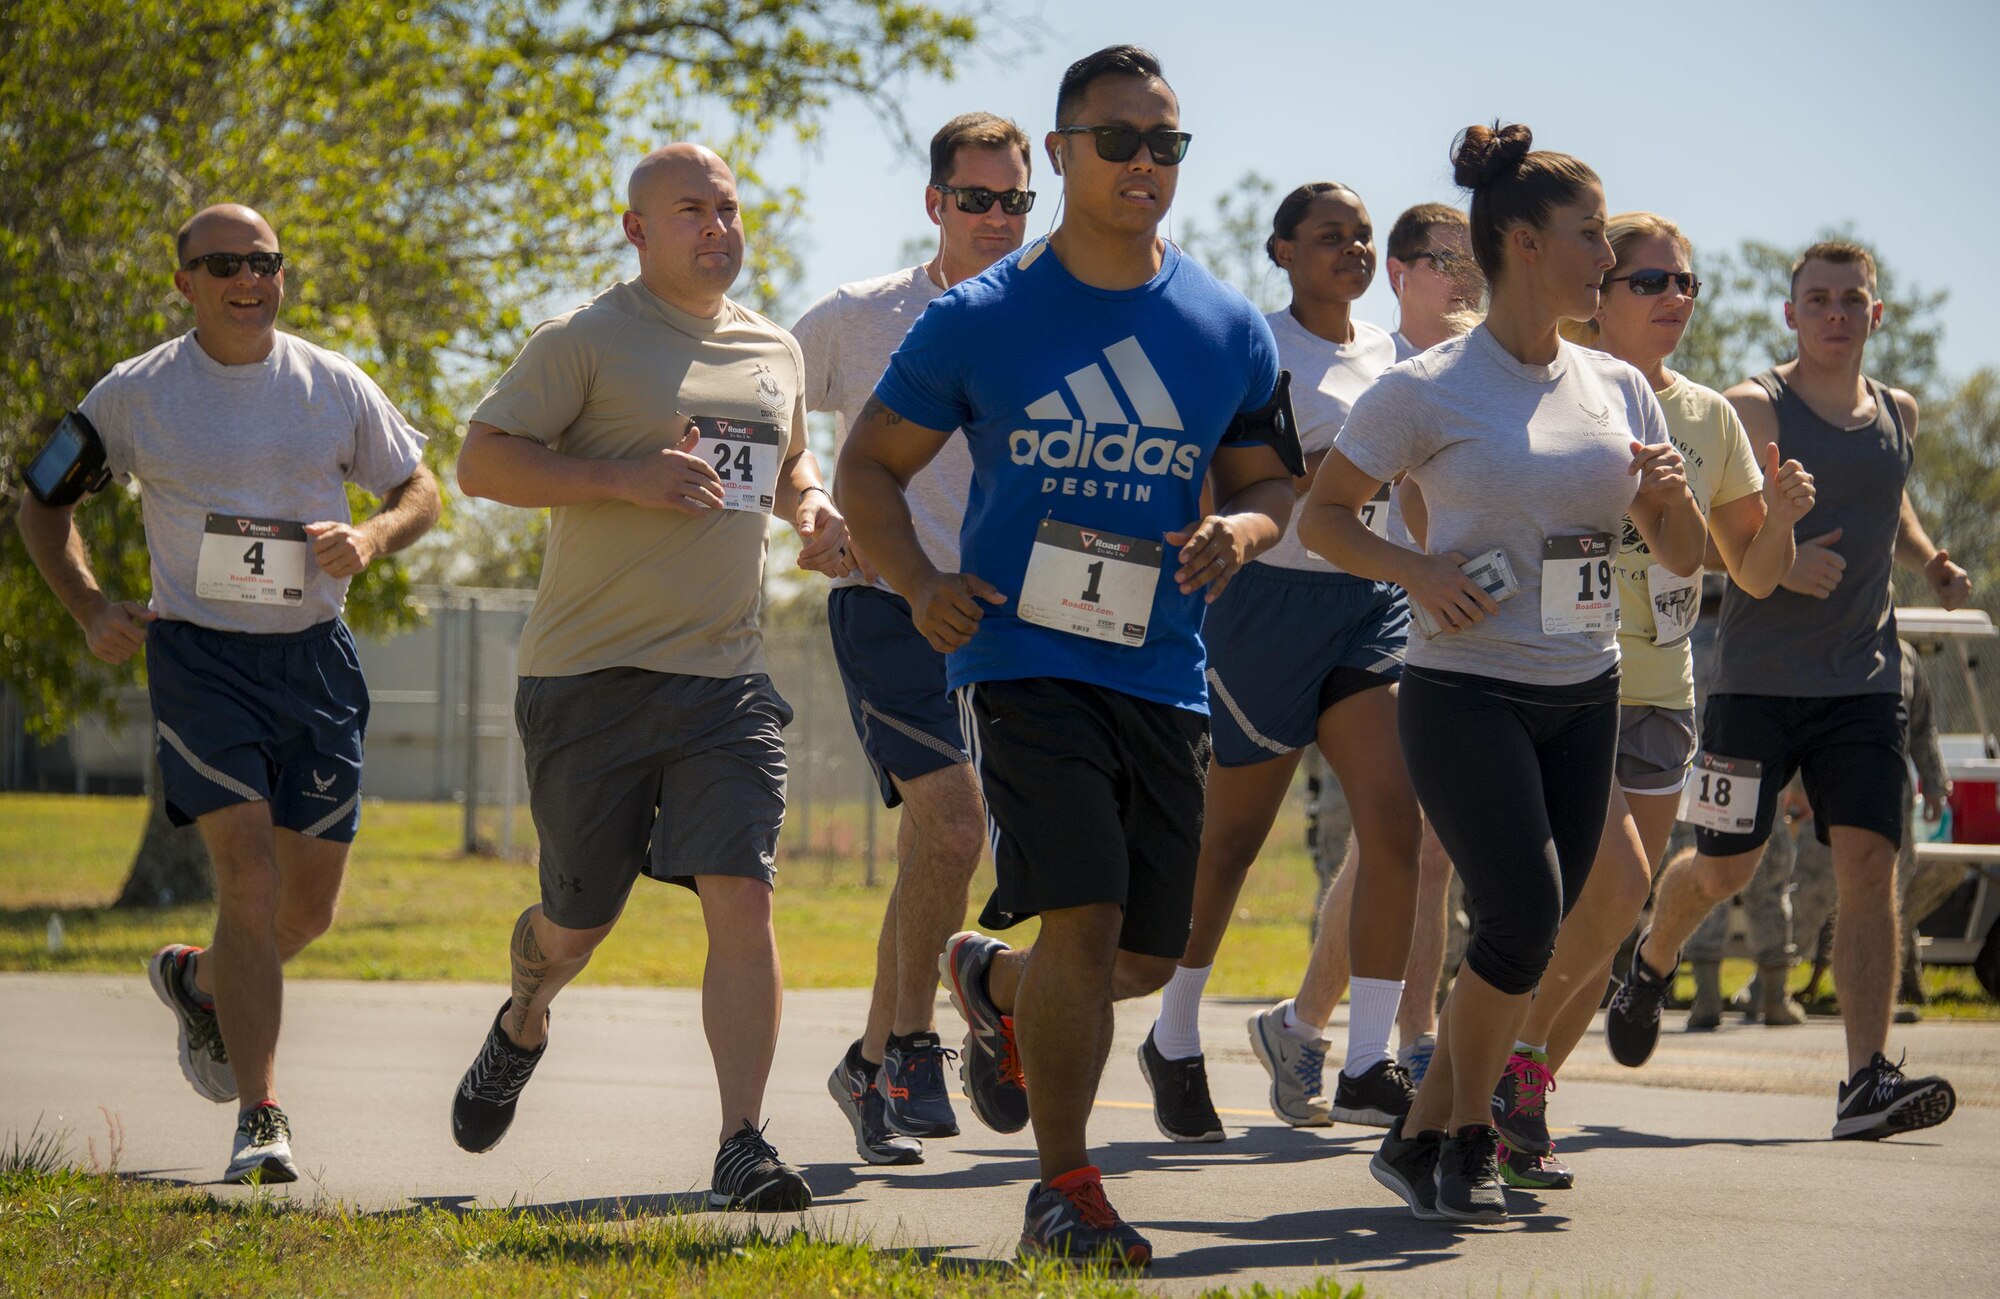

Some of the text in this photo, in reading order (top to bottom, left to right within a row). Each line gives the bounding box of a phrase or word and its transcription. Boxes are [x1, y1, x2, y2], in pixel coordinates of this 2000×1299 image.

[714, 443, 753, 482] 24
[1009, 418, 1202, 480] adidas
[1041, 477, 1152, 502] DESTIN
[243, 541, 265, 575] 4
[1095, 539, 1130, 553] RoadID
[230, 574, 274, 584] RoadID.com
[1081, 560, 1104, 604] 1
[1578, 559, 1611, 602] 19
[1631, 570, 1646, 581] CA
[1061, 598, 1114, 617] RoadID.com
[1699, 773, 1732, 807] 18
